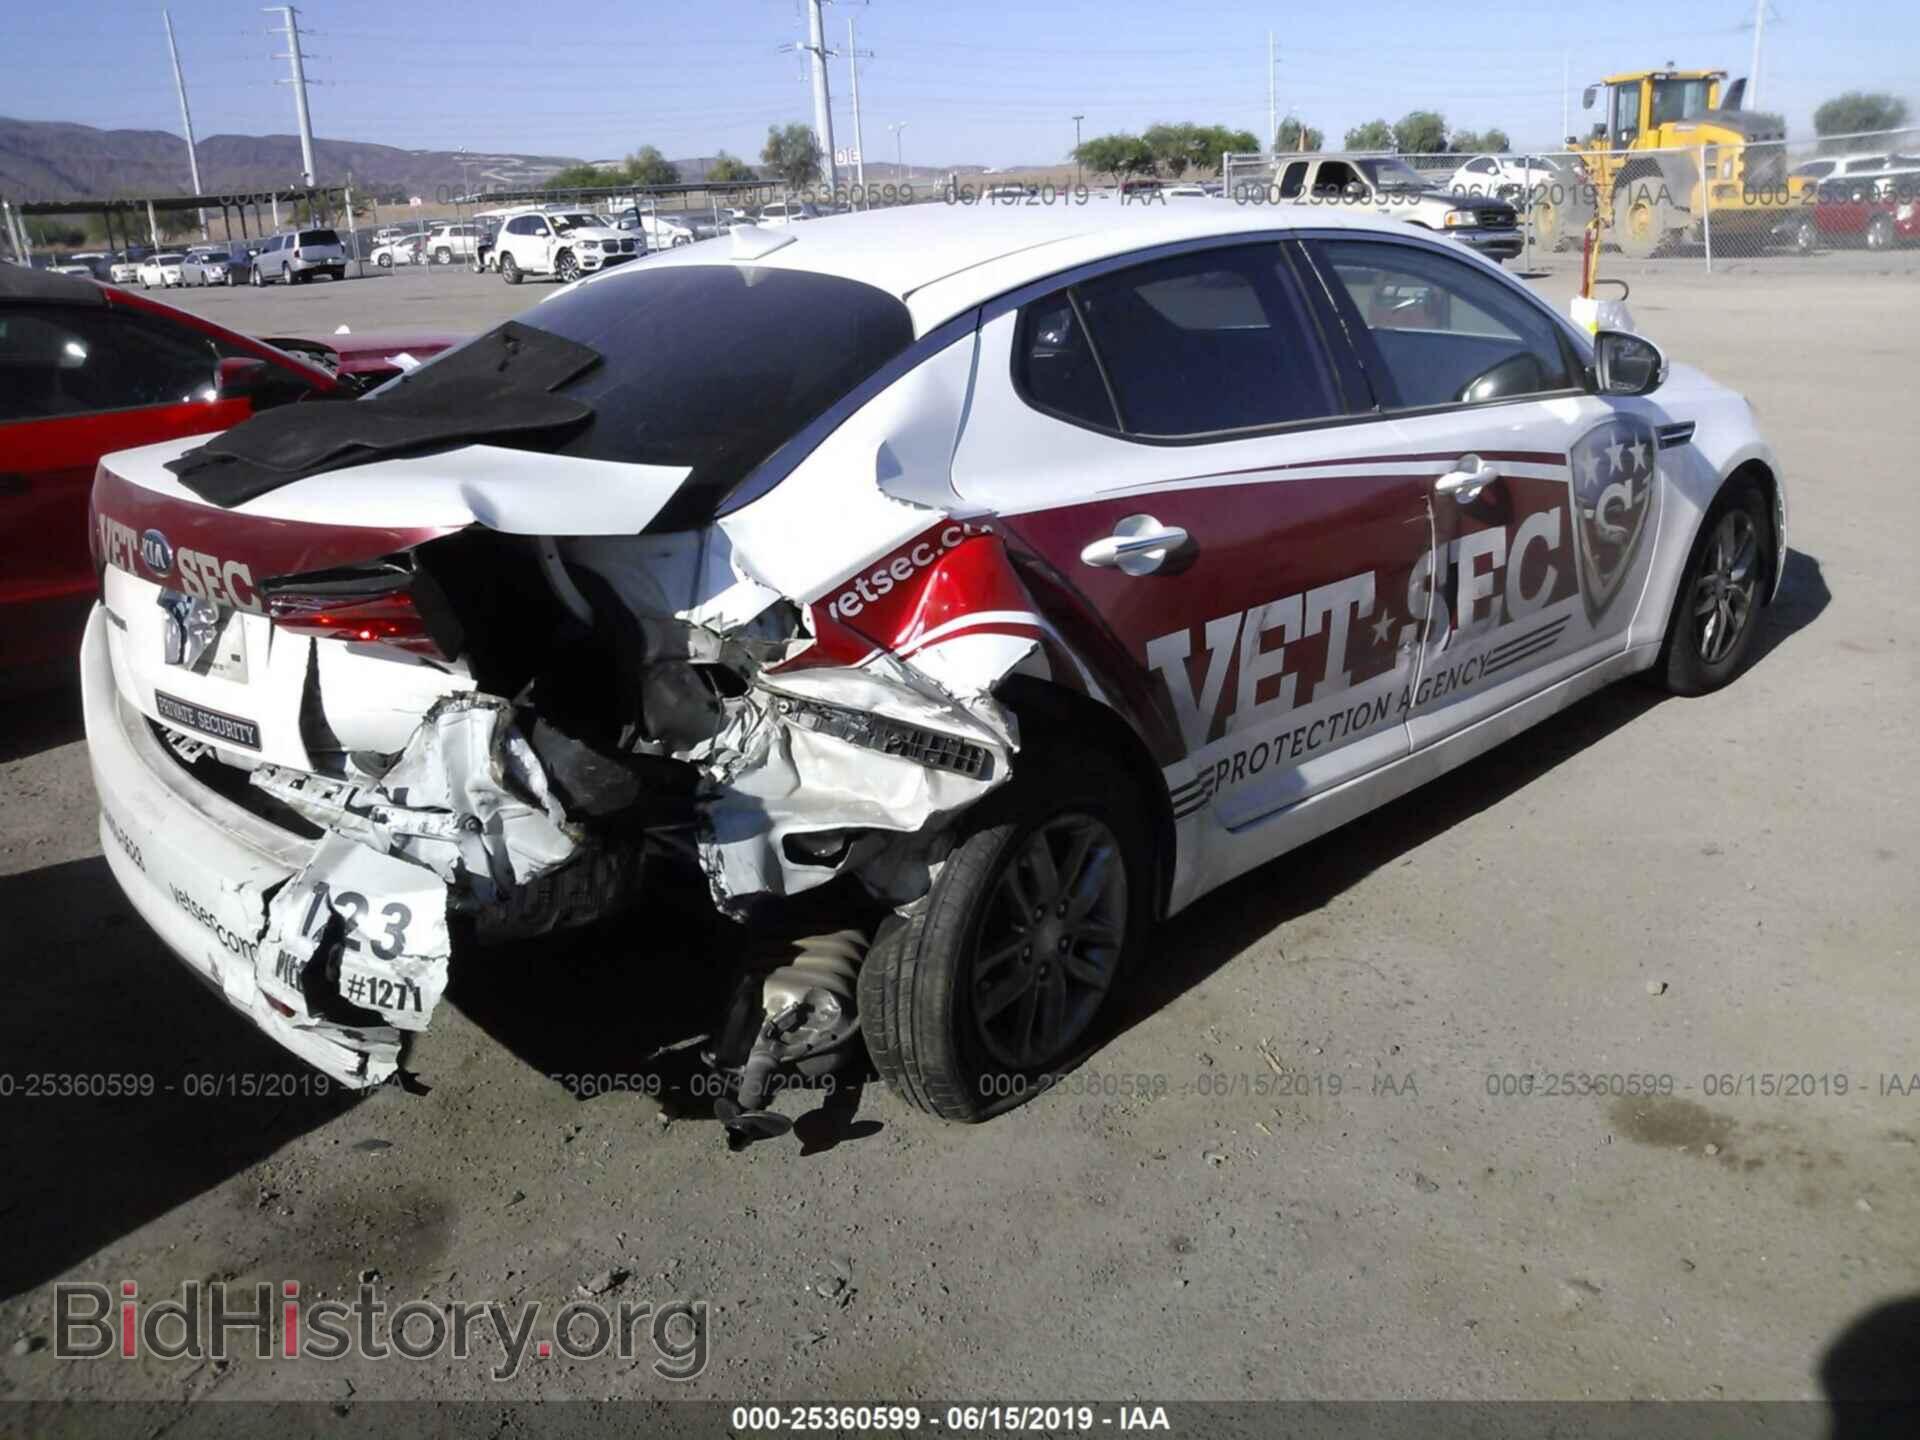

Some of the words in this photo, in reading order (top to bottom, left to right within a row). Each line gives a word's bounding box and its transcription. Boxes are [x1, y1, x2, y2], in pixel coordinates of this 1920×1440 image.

[99, 513, 139, 577] VET
[177, 547, 262, 615] SEC
[143, 537, 167, 570] KIA
[1147, 570, 1376, 757] VET
[1396, 507, 1562, 668] SEC
[158, 696, 195, 724] PRIVATE
[198, 711, 254, 744] SECURITY
[1215, 691, 1393, 793] PROTECTION
[1396, 650, 1492, 724] AGENCY
